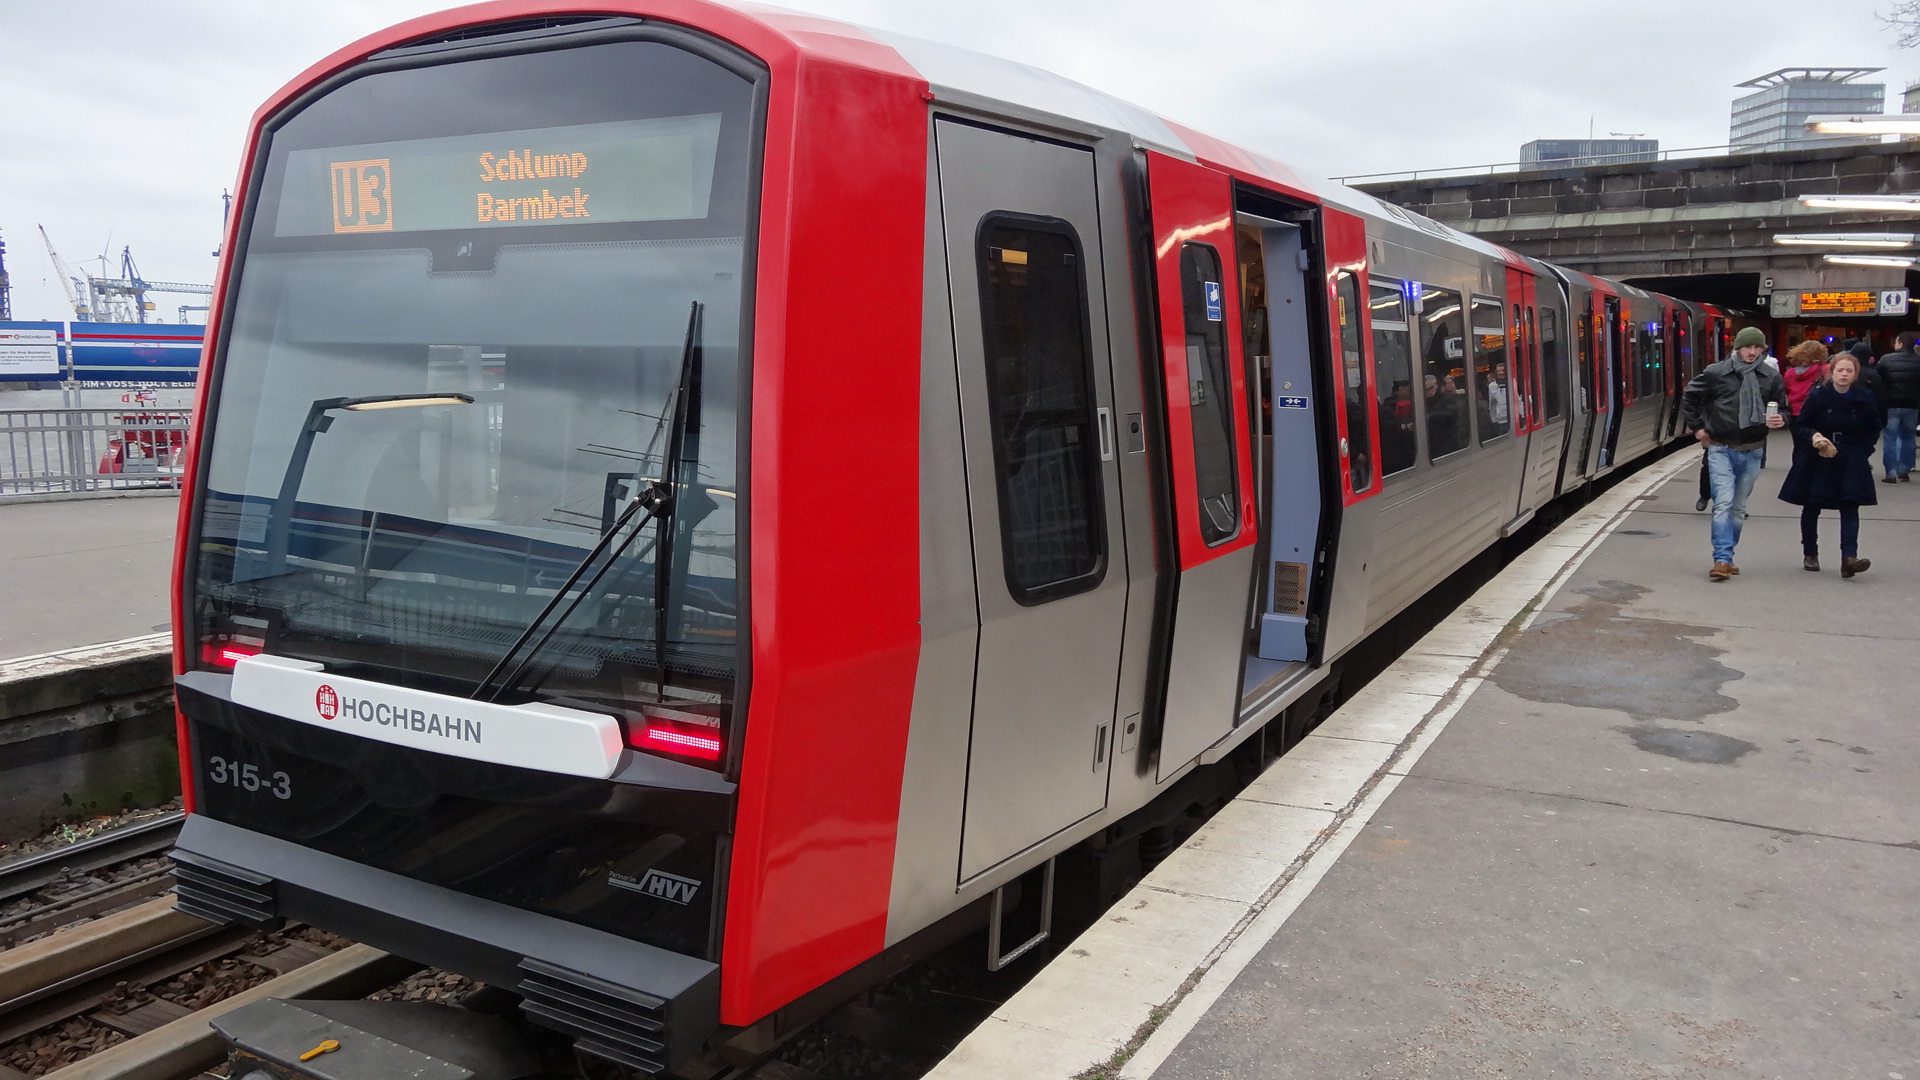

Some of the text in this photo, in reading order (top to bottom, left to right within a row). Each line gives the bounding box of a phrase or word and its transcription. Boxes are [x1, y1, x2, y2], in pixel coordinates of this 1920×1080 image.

[479, 149, 588, 182] Schlump
[334, 163, 390, 229] U3
[477, 187, 591, 222] Barmbek
[342, 696, 481, 744] HOCHBAHN
[209, 755, 292, 800] 315-3
[648, 875, 699, 903] HVV
